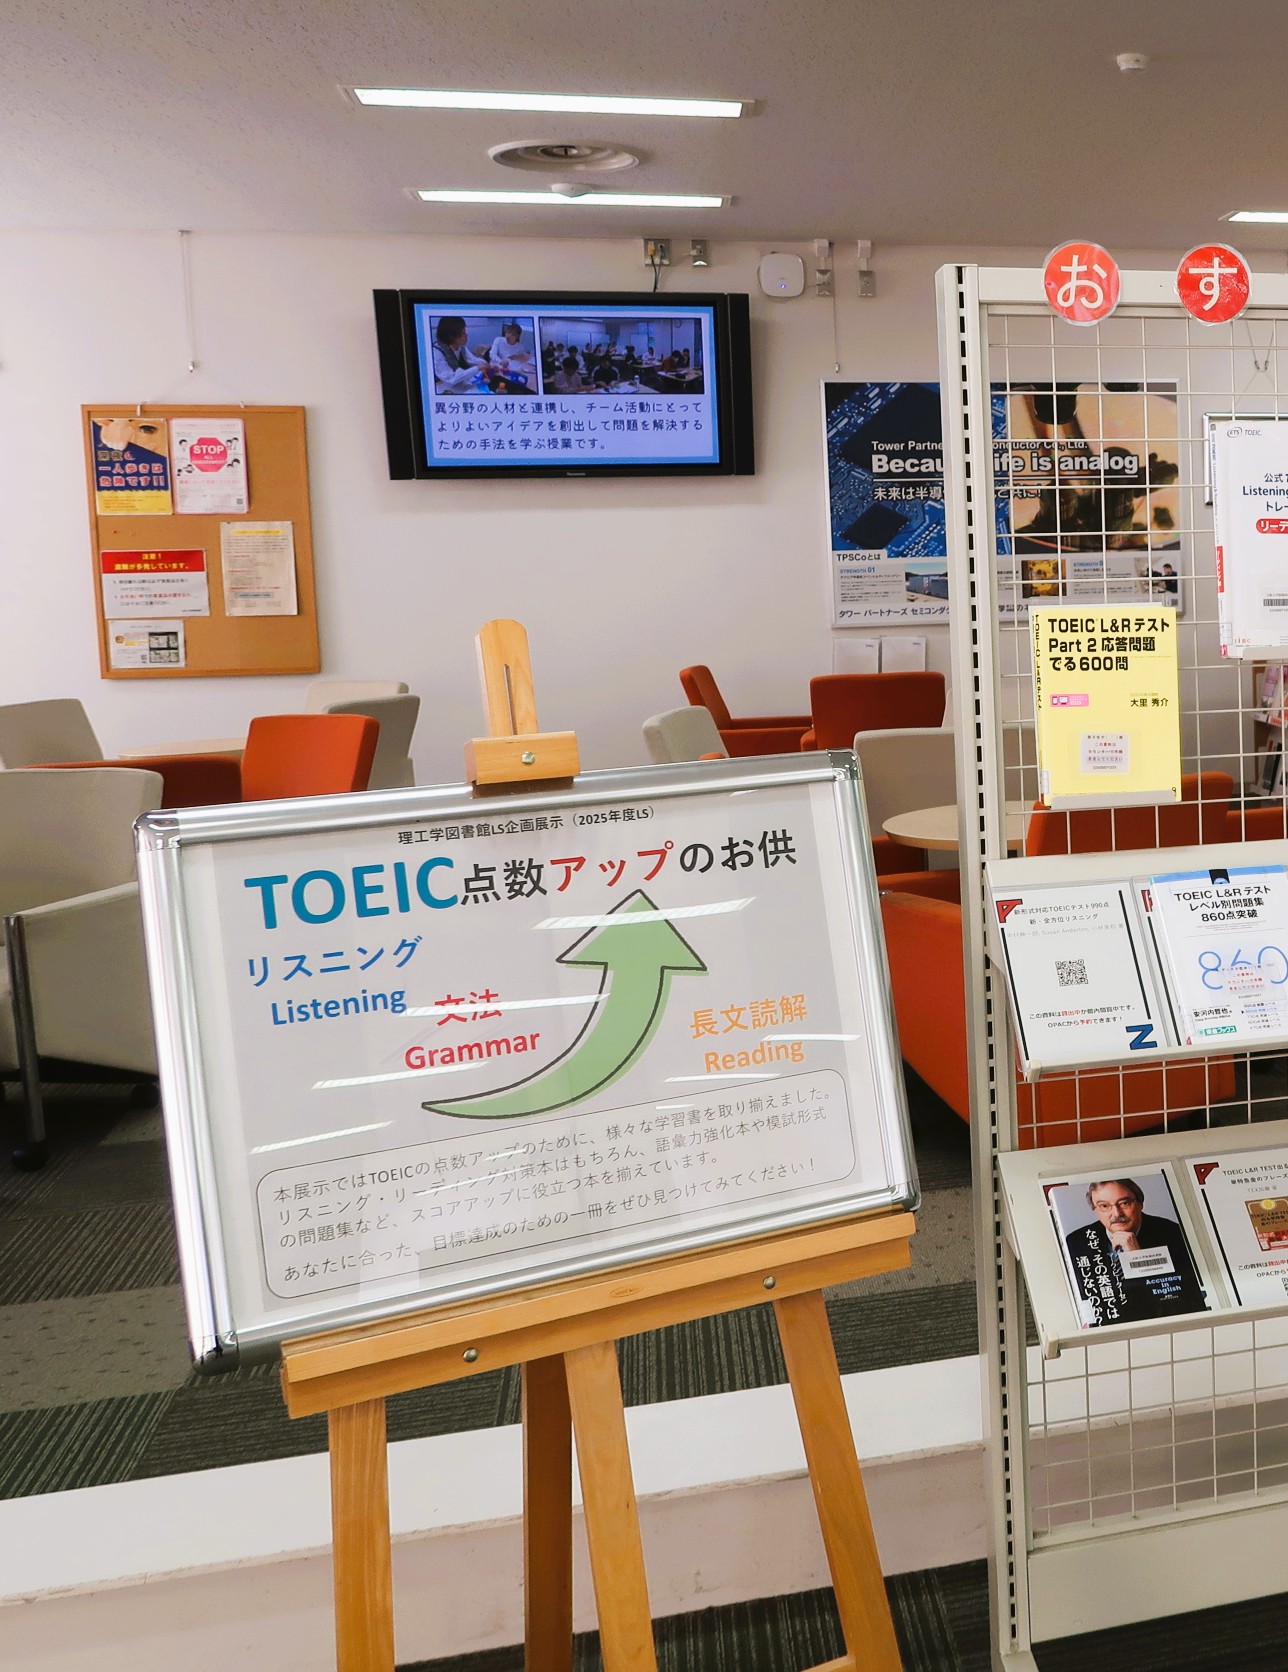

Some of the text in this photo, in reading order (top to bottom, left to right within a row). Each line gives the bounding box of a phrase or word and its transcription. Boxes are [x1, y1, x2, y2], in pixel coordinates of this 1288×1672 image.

[434, 401, 703, 415] 異分野の人材と連携し、チーム活動にとって
[436, 419, 704, 433] よりよいアイデアを創出して問題を解決する
[193, 445, 224, 454] STOP
[437, 437, 606, 451] ための手法を学ぶ授業です。
[871, 441, 905, 451] Tower
[908, 441, 943, 450] Partne
[871, 452, 1138, 474] Becau ife is analog
[1264, 473, 1283, 482] 公式
[874, 487, 944, 500] 未来は半導
[836, 553, 881, 561] TPSCoとは
[864, 608, 908, 616] パートナーズ
[1048, 618, 1170, 632] TOEIC L&R テスト
[1049, 637, 1155, 652] Part 2 応答問題
[1050, 656, 1128, 671] でる600問
[1130, 698, 1168, 707] 大里 秀介
[398, 806, 655, 844] 理工学図書館LS企画展示（2025年度LS）
[244, 829, 797, 929] TOEIC点数アップのお供
[1174, 887, 1271, 902] TOEIC L&R テスト
[1190, 898, 1264, 911] レベル別問題集
[1201, 909, 1258, 922] 860点突破
[248, 935, 422, 987] リスニング
[272, 989, 407, 1026] Listening
[435, 988, 502, 1026] 文法
[690, 994, 808, 1039] 長文読解
[405, 1033, 540, 1070] Grammar
[704, 1041, 805, 1073] Reading
[280, 1150, 718, 1248] の問題集など、スコアアップに役立つ本を揃えています。
[1086, 1229, 1120, 1320] なぜ、その英語では
[1146, 1276, 1181, 1285] Accuracy
[1076, 1256, 1103, 1327] 通じないのか?
[1152, 1286, 1181, 1294] English
